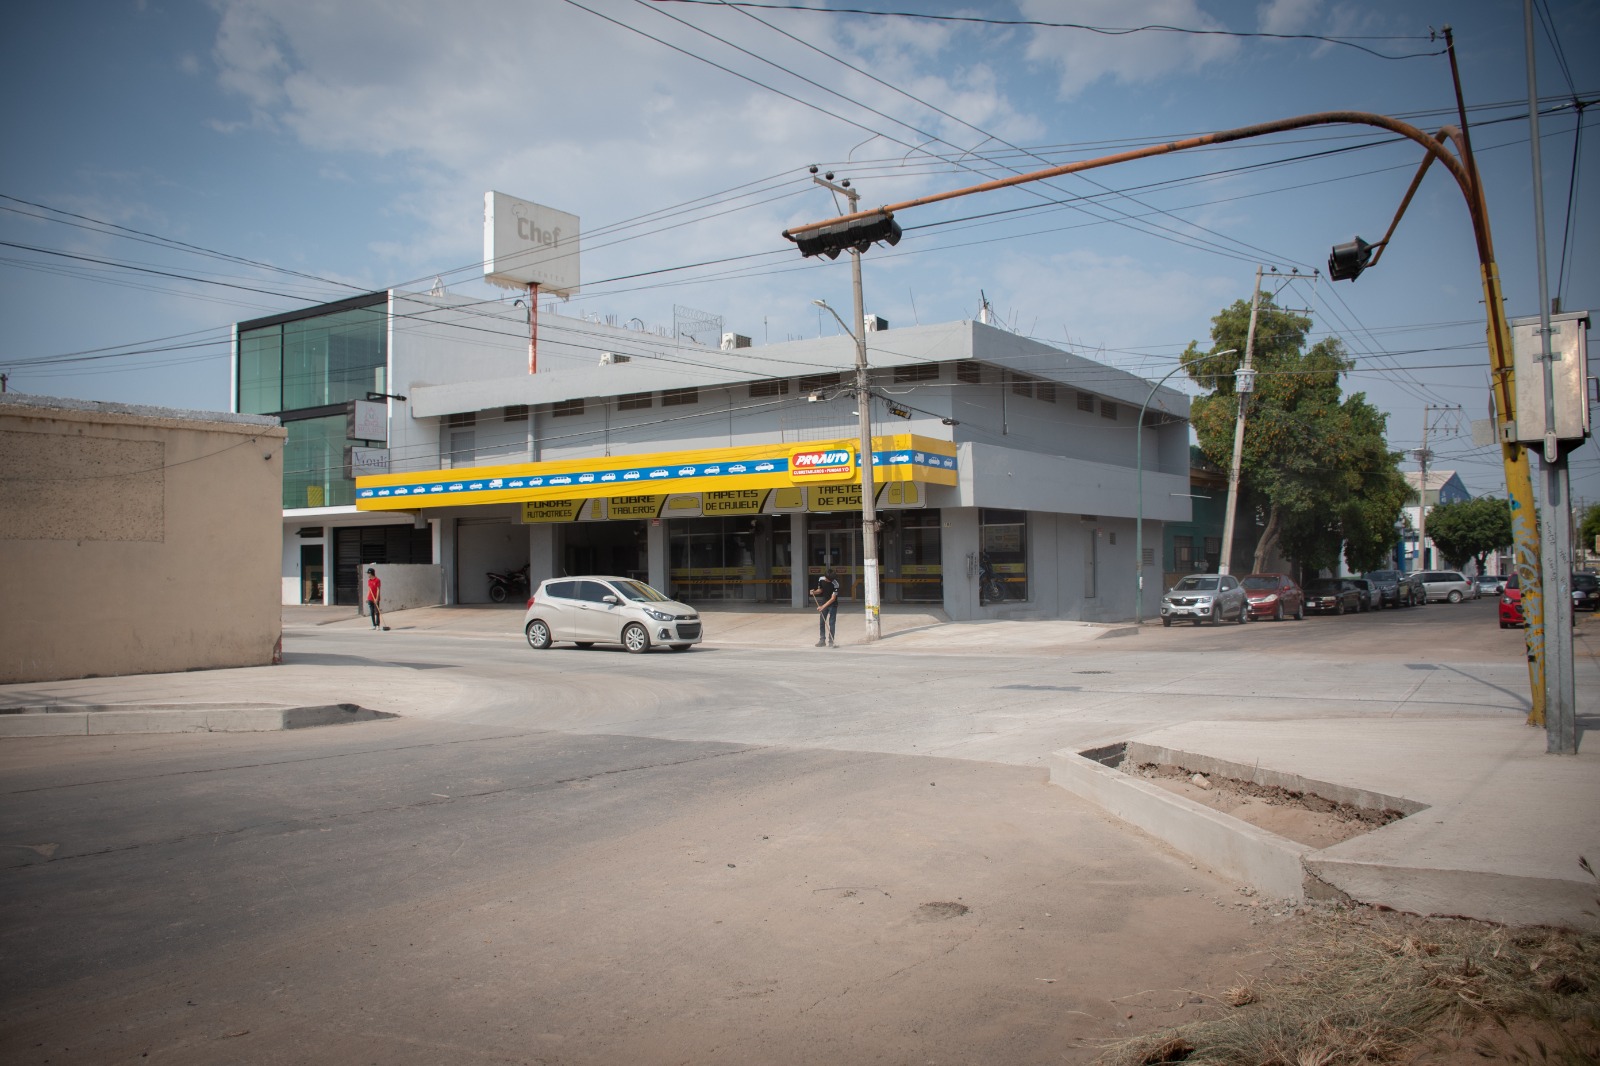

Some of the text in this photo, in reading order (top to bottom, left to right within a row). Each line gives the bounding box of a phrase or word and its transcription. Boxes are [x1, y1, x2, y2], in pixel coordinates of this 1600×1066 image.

[517, 217, 561, 248] Chef
[795, 452, 848, 466] PROAUTO
[706, 489, 759, 499] TAPETES
[818, 484, 863, 494] TAPETES
[527, 499, 572, 508] FUNDAS
[611, 495, 655, 505] CUBRE
[818, 497, 834, 506] DE
[611, 505, 656, 515] TABLEROS
[705, 500, 759, 511] DE CAJUELA
[527, 509, 572, 519] AUTOMOTRICES
